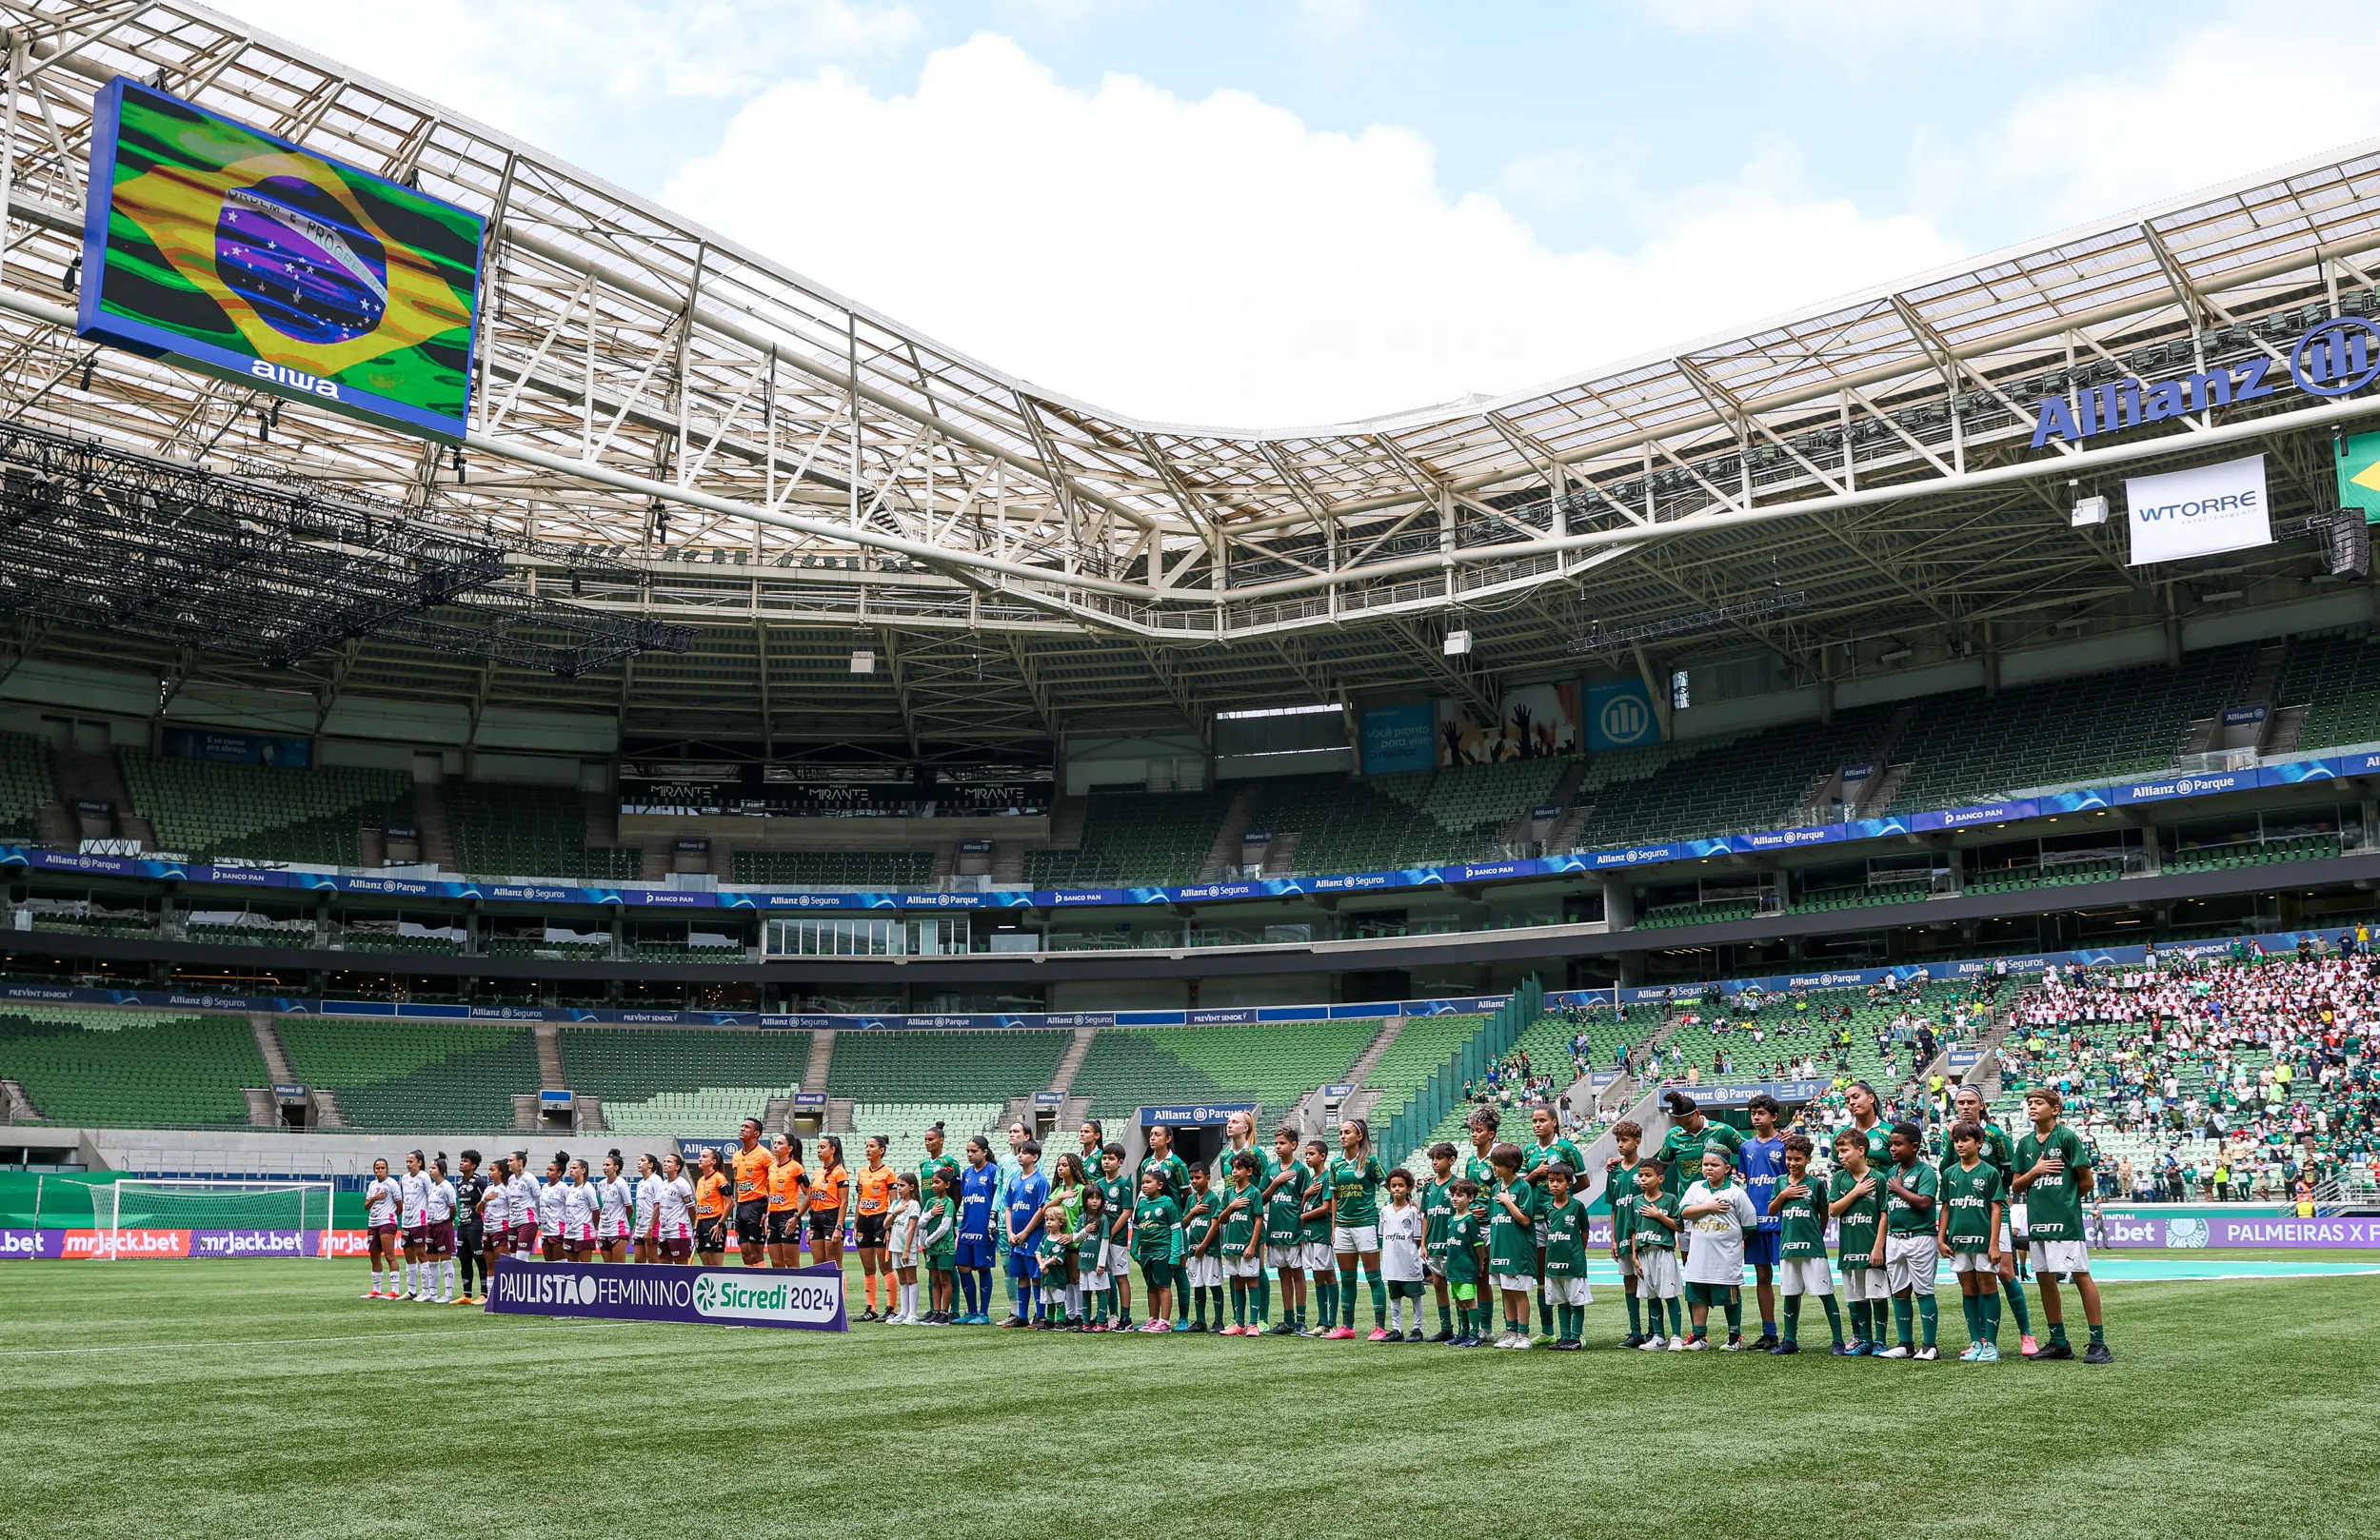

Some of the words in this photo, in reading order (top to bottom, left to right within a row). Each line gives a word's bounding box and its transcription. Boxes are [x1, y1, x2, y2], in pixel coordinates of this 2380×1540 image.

[306, 221, 386, 296] PROGRESSO
[251, 360, 340, 399] aiwa
[2031, 358, 2273, 448] Allianz
[2139, 490, 2256, 522] WTORRE
[2181, 508, 2257, 524] ENTRETENIMENTO
[2227, 711, 2253, 721] Allianz
[1366, 727, 1392, 738] Você
[1394, 725, 1430, 738] pronto
[1380, 739, 1405, 748] para
[1844, 769, 1866, 778] Allianz
[650, 785, 711, 799] MIRANTE
[964, 787, 1024, 800] MIRANTE
[2132, 783, 2174, 798] Allianz
[2193, 777, 2234, 791] Parque
[809, 789, 869, 800] MIRANTE
[1535, 808, 1554, 817] Allianz
[1955, 812, 1984, 821] BANCO
[1985, 809, 2003, 819] PAN
[1753, 834, 1783, 845] Allianz
[1795, 830, 1825, 841] Parque
[1597, 853, 1625, 864] Allianz
[1637, 848, 1669, 860] Seguros
[46, 855, 77, 866] Allianz
[91, 859, 121, 870] Parque
[348, 879, 382, 890] Allianz
[397, 882, 426, 893] Parque
[1316, 878, 1343, 888] Allianz
[1356, 876, 1384, 886] Seguros
[493, 887, 523, 897] Allianz
[535, 889, 565, 899] Seguros
[1180, 887, 1207, 898] Allianz
[1220, 886, 1249, 896] Seguros
[810, 897, 840, 906] Seguros
[906, 896, 937, 904] Allianz
[950, 896, 979, 906] Parque
[2007, 958, 2044, 970] Seguros
[1790, 977, 1819, 986] Allianz
[1833, 974, 1860, 984] Parque
[9, 989, 41, 997] PREVENT
[42, 990, 68, 998] SENIOR
[170, 996, 201, 1005] Allianz
[214, 997, 246, 1008] Seguros
[1478, 1000, 1505, 1009] Allianz
[472, 1008, 500, 1017] Allianz
[512, 1009, 543, 1018] Seguros
[624, 1013, 650, 1021] PREVENT
[1194, 1014, 1220, 1022] PREVENT
[800, 1017, 828, 1027] Seguros
[944, 1017, 969, 1027] Parque
[1084, 1016, 1112, 1024] Seguros
[1154, 1110, 1191, 1120] Allianz
[1950, 1195, 1984, 1209] crefisa
[1693, 1218, 1730, 1233] crefisa
[1385, 1233, 1405, 1242] crefisa
[2228, 1224, 2345, 1242] PALMEIRAS
[2350, 1224, 2365, 1242] X
[500, 1273, 597, 1305] PAULISTÃO
[598, 1279, 690, 1307] FEMININO
[720, 1282, 785, 1310] Sicredi
[791, 1287, 834, 1312] 2024
